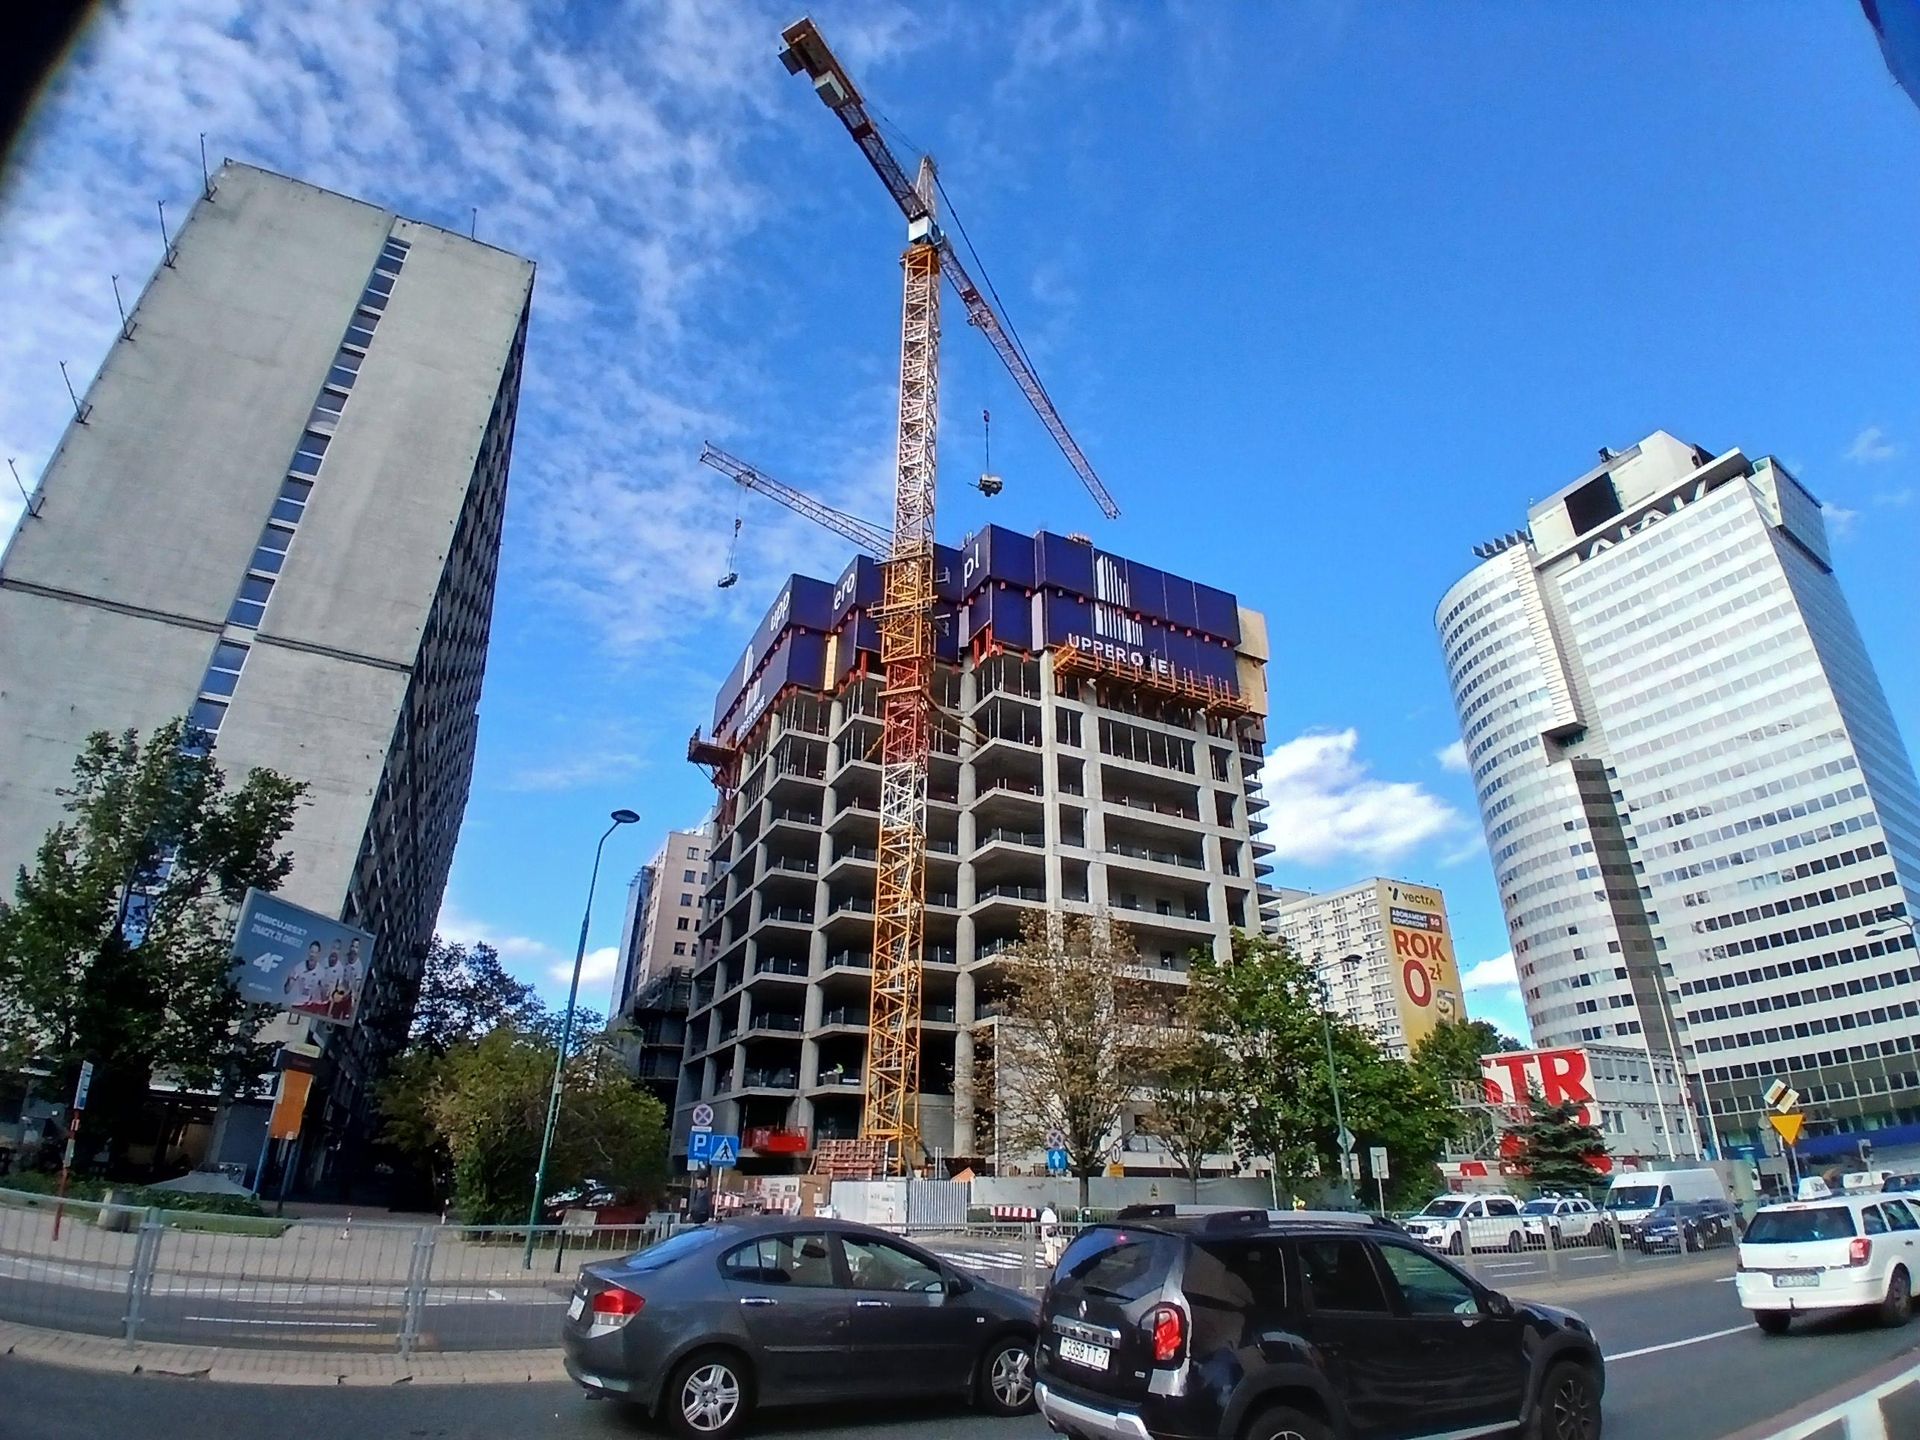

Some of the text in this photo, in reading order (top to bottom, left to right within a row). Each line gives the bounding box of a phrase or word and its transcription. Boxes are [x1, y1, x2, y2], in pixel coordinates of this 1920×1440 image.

[963, 542, 980, 588] pl
[770, 590, 791, 632] upp
[1130, 651, 1169, 674] OE
[1401, 891, 1436, 907] vectra
[1393, 928, 1448, 963] ROK
[252, 951, 285, 974] 4F
[693, 1133, 707, 1152] P
